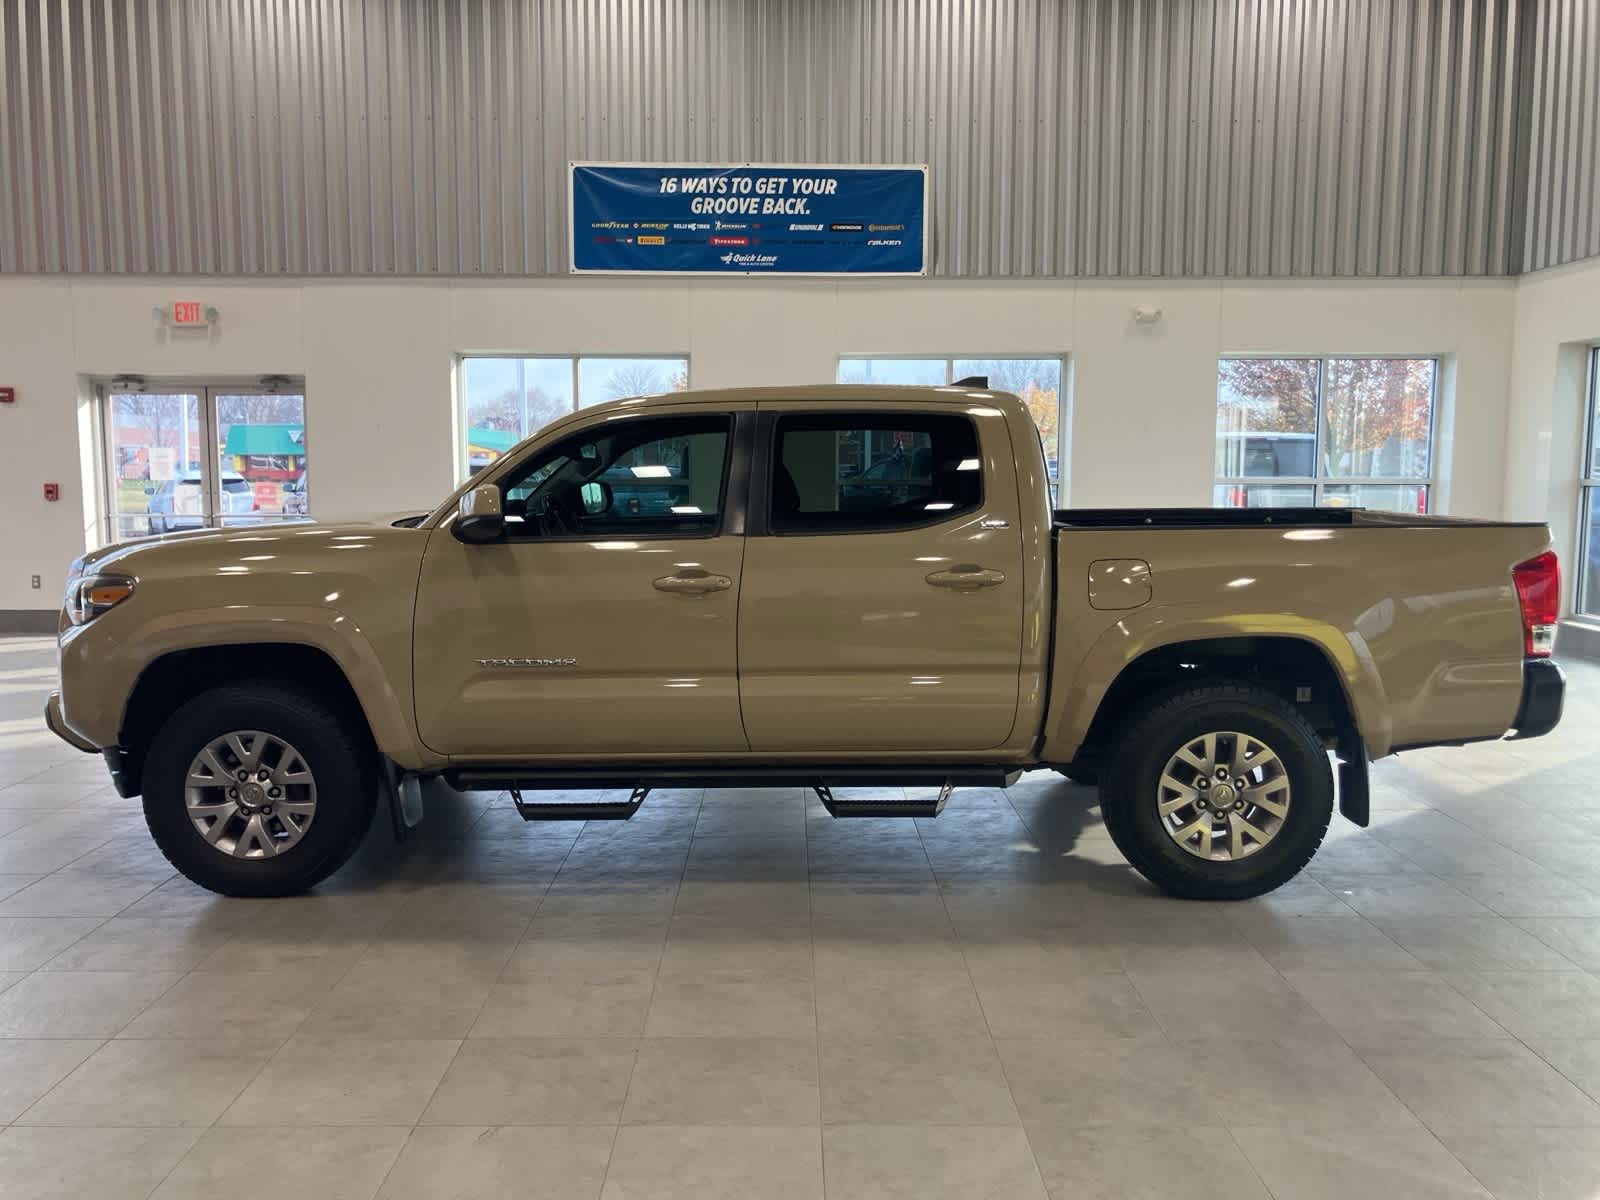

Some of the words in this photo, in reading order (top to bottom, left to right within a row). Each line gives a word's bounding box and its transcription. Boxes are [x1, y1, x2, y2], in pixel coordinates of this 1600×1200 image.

[659, 177, 677, 193] 16
[680, 177, 728, 194] WAYS
[731, 177, 752, 194] TO
[755, 178, 788, 194] GET
[792, 178, 838, 195] YOUR
[690, 197, 759, 215] GROOVE
[762, 198, 811, 215] BACK.
[732, 253, 757, 263] Quick
[756, 253, 778, 263] Lane
[174, 302, 201, 322] EXIT
